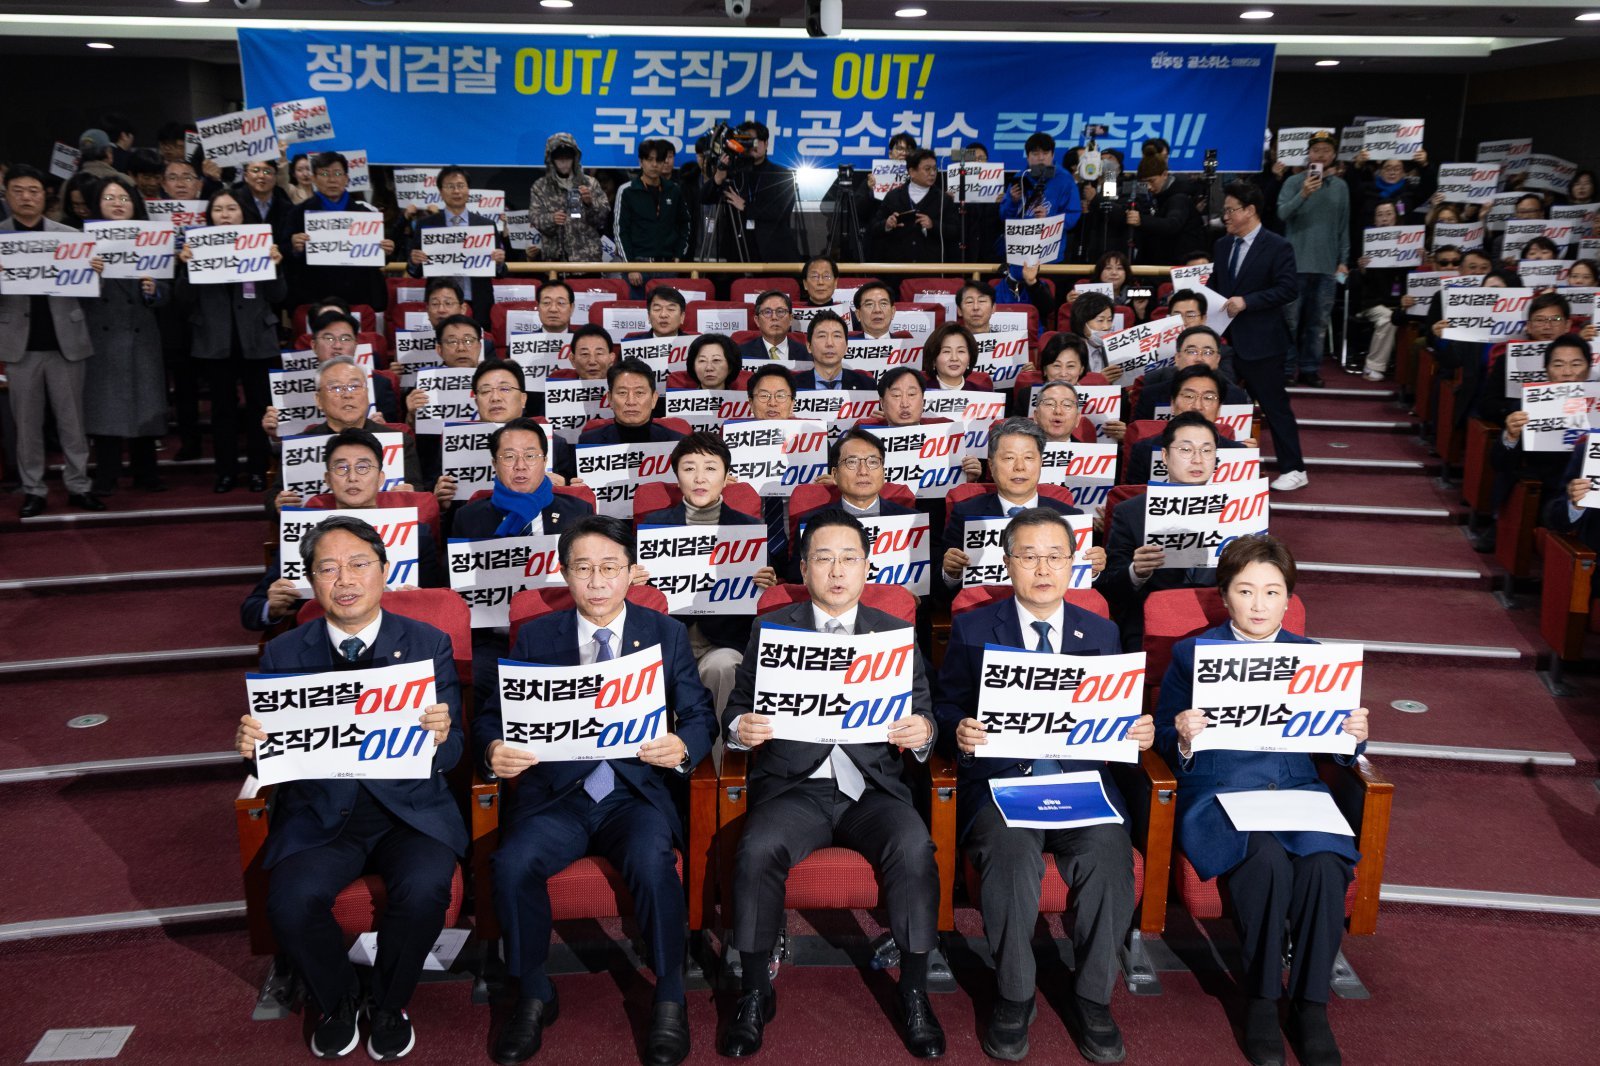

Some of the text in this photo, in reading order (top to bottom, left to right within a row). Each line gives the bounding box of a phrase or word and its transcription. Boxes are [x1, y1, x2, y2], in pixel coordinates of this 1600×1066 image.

[306, 44, 936, 100] 정치검찰 OUT! 조작기소 OUT!
[201, 116, 268, 138] 정치검찰 OUT
[1396, 125, 1425, 138] OUT
[205, 139, 250, 160] 조작기소
[247, 135, 276, 157] OUT
[1394, 142, 1423, 155] OUT
[396, 173, 427, 187] 정치검찰
[978, 168, 1004, 180] OUT
[1471, 170, 1500, 181] OUT
[397, 190, 428, 201] 조작기소
[977, 184, 1004, 197] OUT
[1468, 186, 1498, 198] OUT
[478, 197, 505, 208] OUT
[306, 218, 384, 236] 정치검찰 OUT
[1006, 221, 1064, 240] 정치검찰 OUT
[1464, 227, 1484, 241] OUT
[1541, 227, 1570, 239] OUT
[135, 230, 175, 247] OUT
[188, 231, 239, 249] 정치검찰
[234, 232, 272, 250] OUT
[423, 231, 495, 249] 정치검찰 OUT
[1396, 231, 1425, 244] OUT
[1, 239, 95, 260] 정치검찰 OUT
[307, 240, 381, 258] 조작기소 OUT
[1007, 240, 1062, 259] 조작기소 OUT
[136, 254, 175, 271] OUT
[190, 255, 271, 274] 조작기소 OUT
[463, 255, 493, 269] OUT
[3, 264, 95, 286] 조작기소 OUT
[1174, 266, 1212, 279] 공소취소
[1449, 294, 1499, 307] 정치검찰
[1493, 296, 1534, 312] OUT
[611, 320, 646, 330] 국회의원
[705, 321, 740, 331] 국회의원
[893, 323, 928, 333] 국회의원
[1447, 316, 1526, 336] 조작기소 OUT
[398, 337, 436, 352] 정치검
[512, 339, 563, 354] 정치검찰
[1106, 325, 1152, 352] 공소취소
[623, 343, 673, 359] 정치검찰
[887, 347, 924, 364] OUT
[992, 339, 1028, 359] OUT
[419, 375, 475, 392] 정치검찰
[547, 386, 606, 403] 정치검찰
[1526, 385, 1585, 403] 공소취소
[417, 403, 476, 421] 조작기소
[667, 396, 724, 412] 정치검찰
[837, 400, 882, 419] OUT
[922, 398, 1006, 421] 치검찰 OUT
[1081, 395, 1121, 414] OUT
[445, 433, 492, 452] 정치검
[725, 428, 786, 448] 정치검찰
[781, 431, 829, 455] OUT
[919, 433, 966, 458] OUT
[579, 451, 644, 473] 정치검찰
[1066, 454, 1117, 476] OUT
[1213, 459, 1260, 483] OUT
[781, 463, 828, 486] OUT
[919, 465, 963, 489] OUT
[1070, 485, 1114, 505] OUT
[1149, 491, 1269, 523] 정치검찰 OUT
[873, 525, 930, 555] OUT
[1146, 530, 1224, 551] 조작기소
[451, 546, 532, 573] 정치검찰
[640, 535, 767, 566] 정치검찰 OUT
[874, 560, 931, 585] OUT
[760, 643, 914, 684] 정치검찰 OUT
[503, 660, 663, 710] 정치검찰 OUT
[984, 664, 1146, 704] 정치검찰 OUT
[1197, 656, 1363, 695] 정치검찰 OUT
[252, 675, 436, 716] 정치검찰 OUT
[755, 691, 913, 730] 조작기소 OUT
[505, 705, 666, 748] 조작기소 OUT
[981, 711, 1142, 746] 조작기소 OUT
[1197, 703, 1353, 738] 조작기소 OUT
[259, 723, 430, 762] 조작기소 OUT
